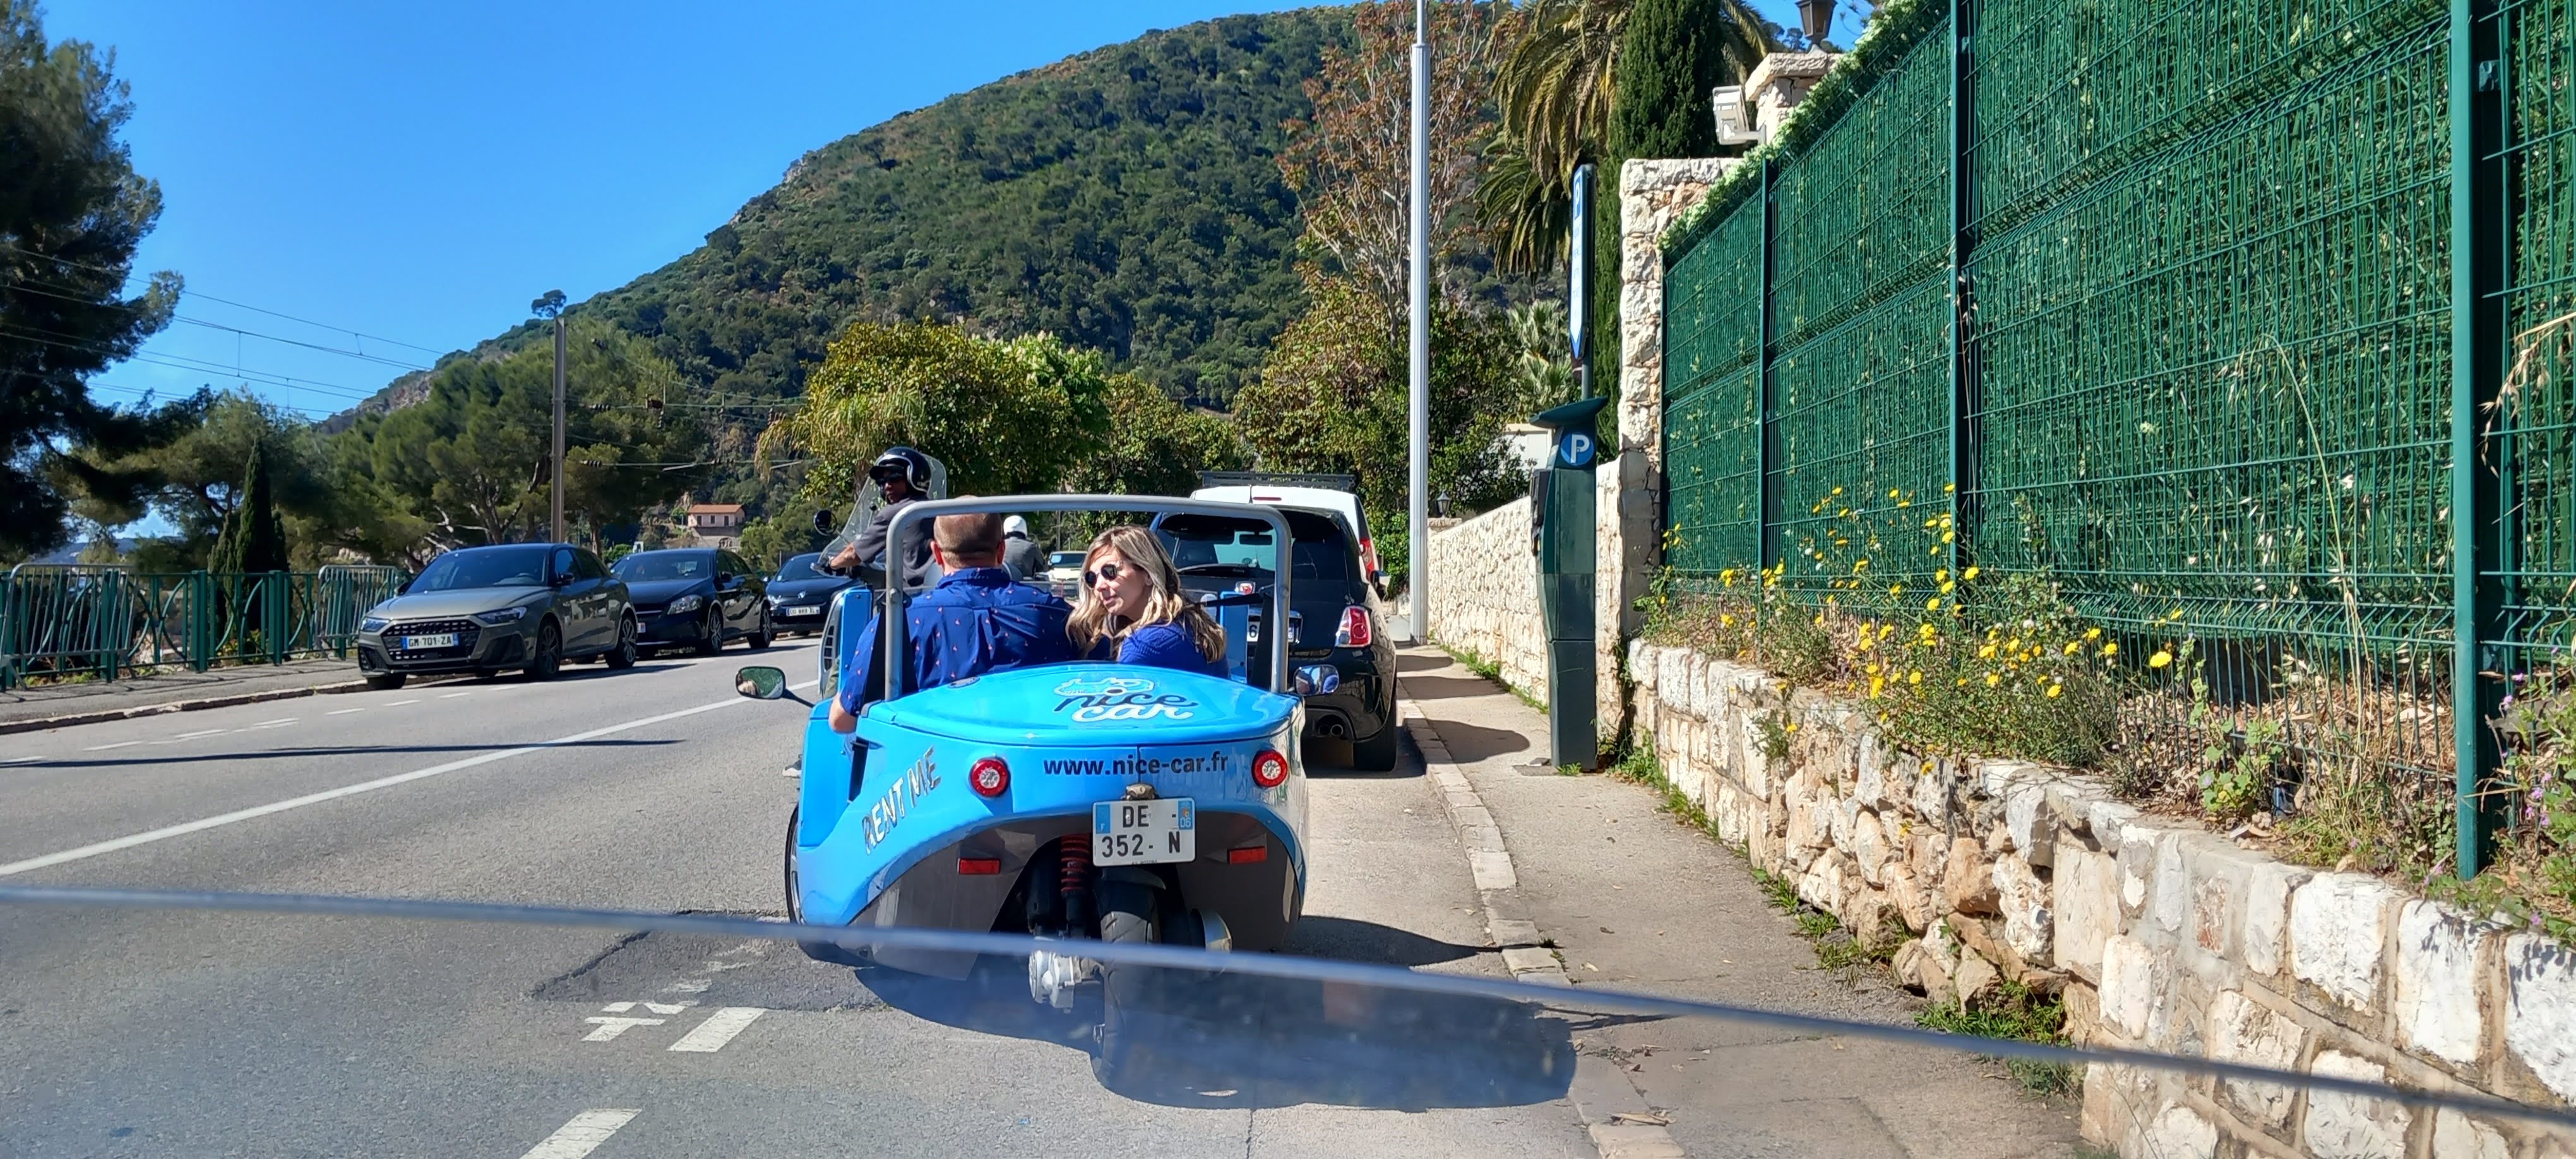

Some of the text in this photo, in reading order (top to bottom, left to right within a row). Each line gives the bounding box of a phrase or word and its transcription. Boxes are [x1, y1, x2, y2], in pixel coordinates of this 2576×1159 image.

[1570, 434, 1590, 463] P
[1053, 694, 1198, 712] nice
[1071, 703, 1194, 722] car
[1043, 751, 1229, 775] www.nice-car.fr
[862, 745, 941, 856] RENT ME
